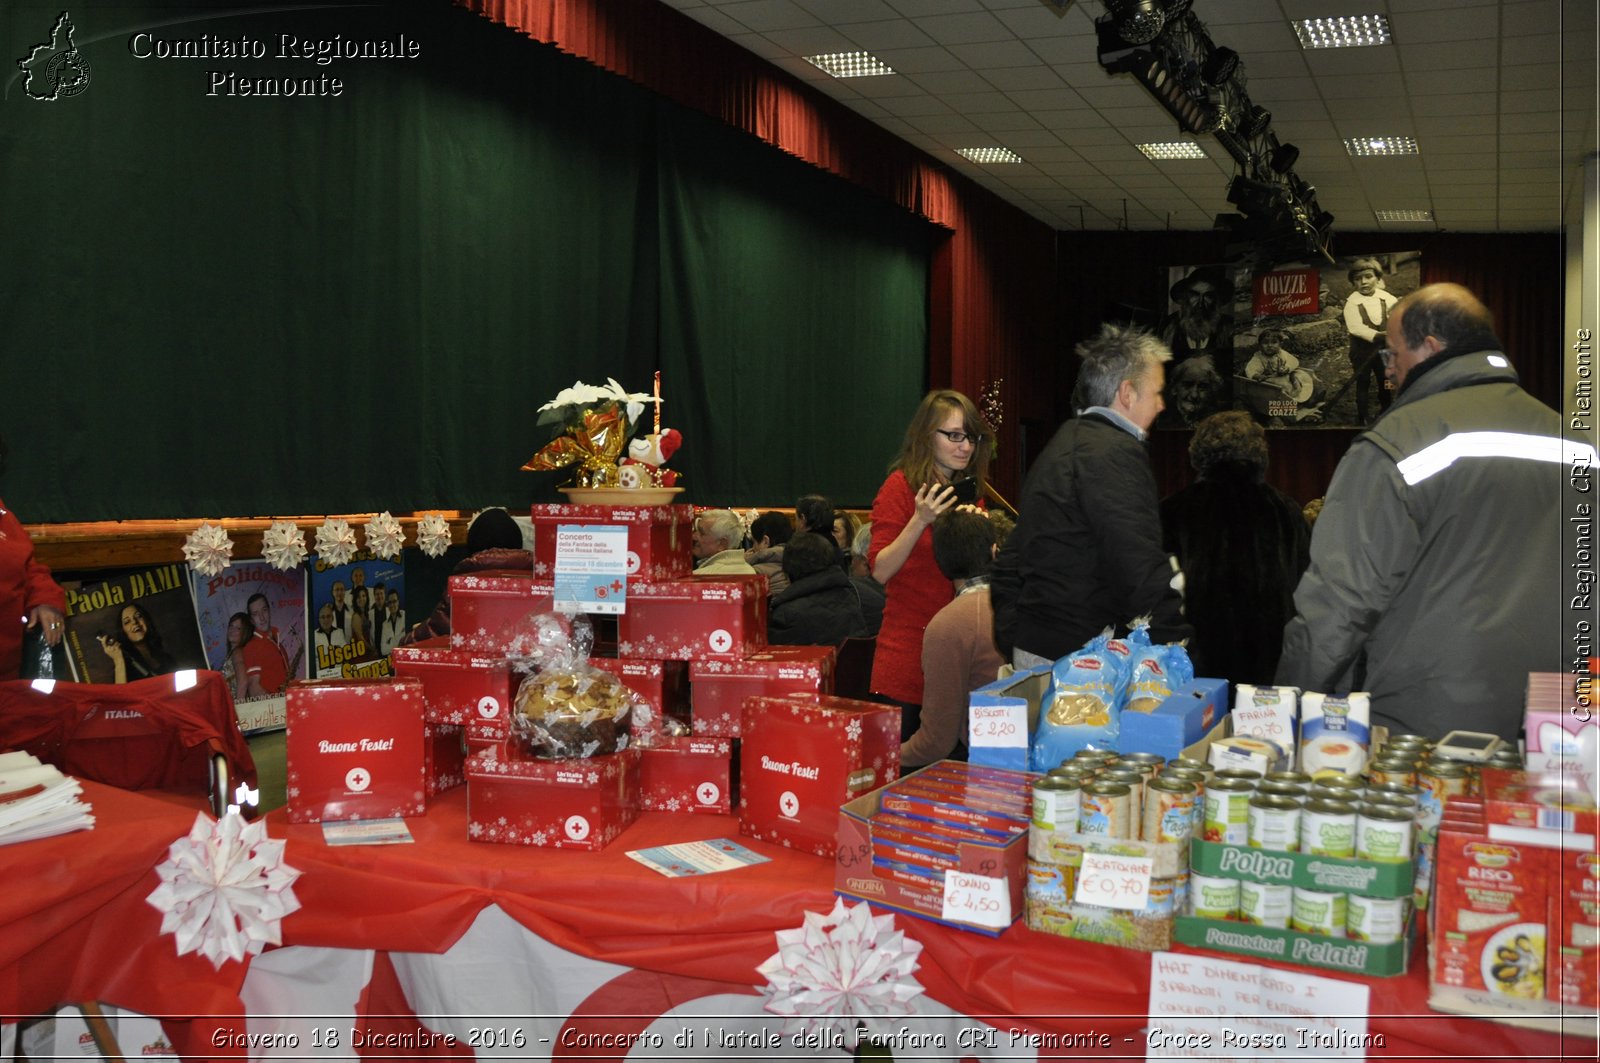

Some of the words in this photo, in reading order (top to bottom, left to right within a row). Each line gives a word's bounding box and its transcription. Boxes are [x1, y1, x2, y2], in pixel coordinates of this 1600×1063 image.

[1262, 274, 1307, 295] COAZZE
[1268, 408, 1297, 417] COAZZE
[559, 533, 593, 541] Concerto
[65, 582, 125, 616] Paola
[130, 565, 182, 600] DAMI
[317, 638, 366, 670] Liscio
[105, 710, 143, 719] ITALIA
[1238, 709, 1277, 722] FARINA
[973, 722, 984, 737] €
[987, 721, 1016, 737] 2,20
[319, 740, 358, 754] Buone
[359, 738, 394, 752] Feste!
[761, 755, 790, 774] Buone
[791, 762, 819, 780] Feste!
[1220, 848, 1293, 879] Polpa
[1468, 866, 1513, 881] RISO
[951, 876, 990, 891] TONNO
[899, 887, 921, 899] Tonno
[947, 890, 960, 908] €
[964, 893, 1000, 912] 4,50
[1206, 928, 1285, 954] Pomodori
[1293, 938, 1368, 969] Pelati
[1159, 960, 1191, 975] HAI
[1235, 991, 1260, 1004] PER
